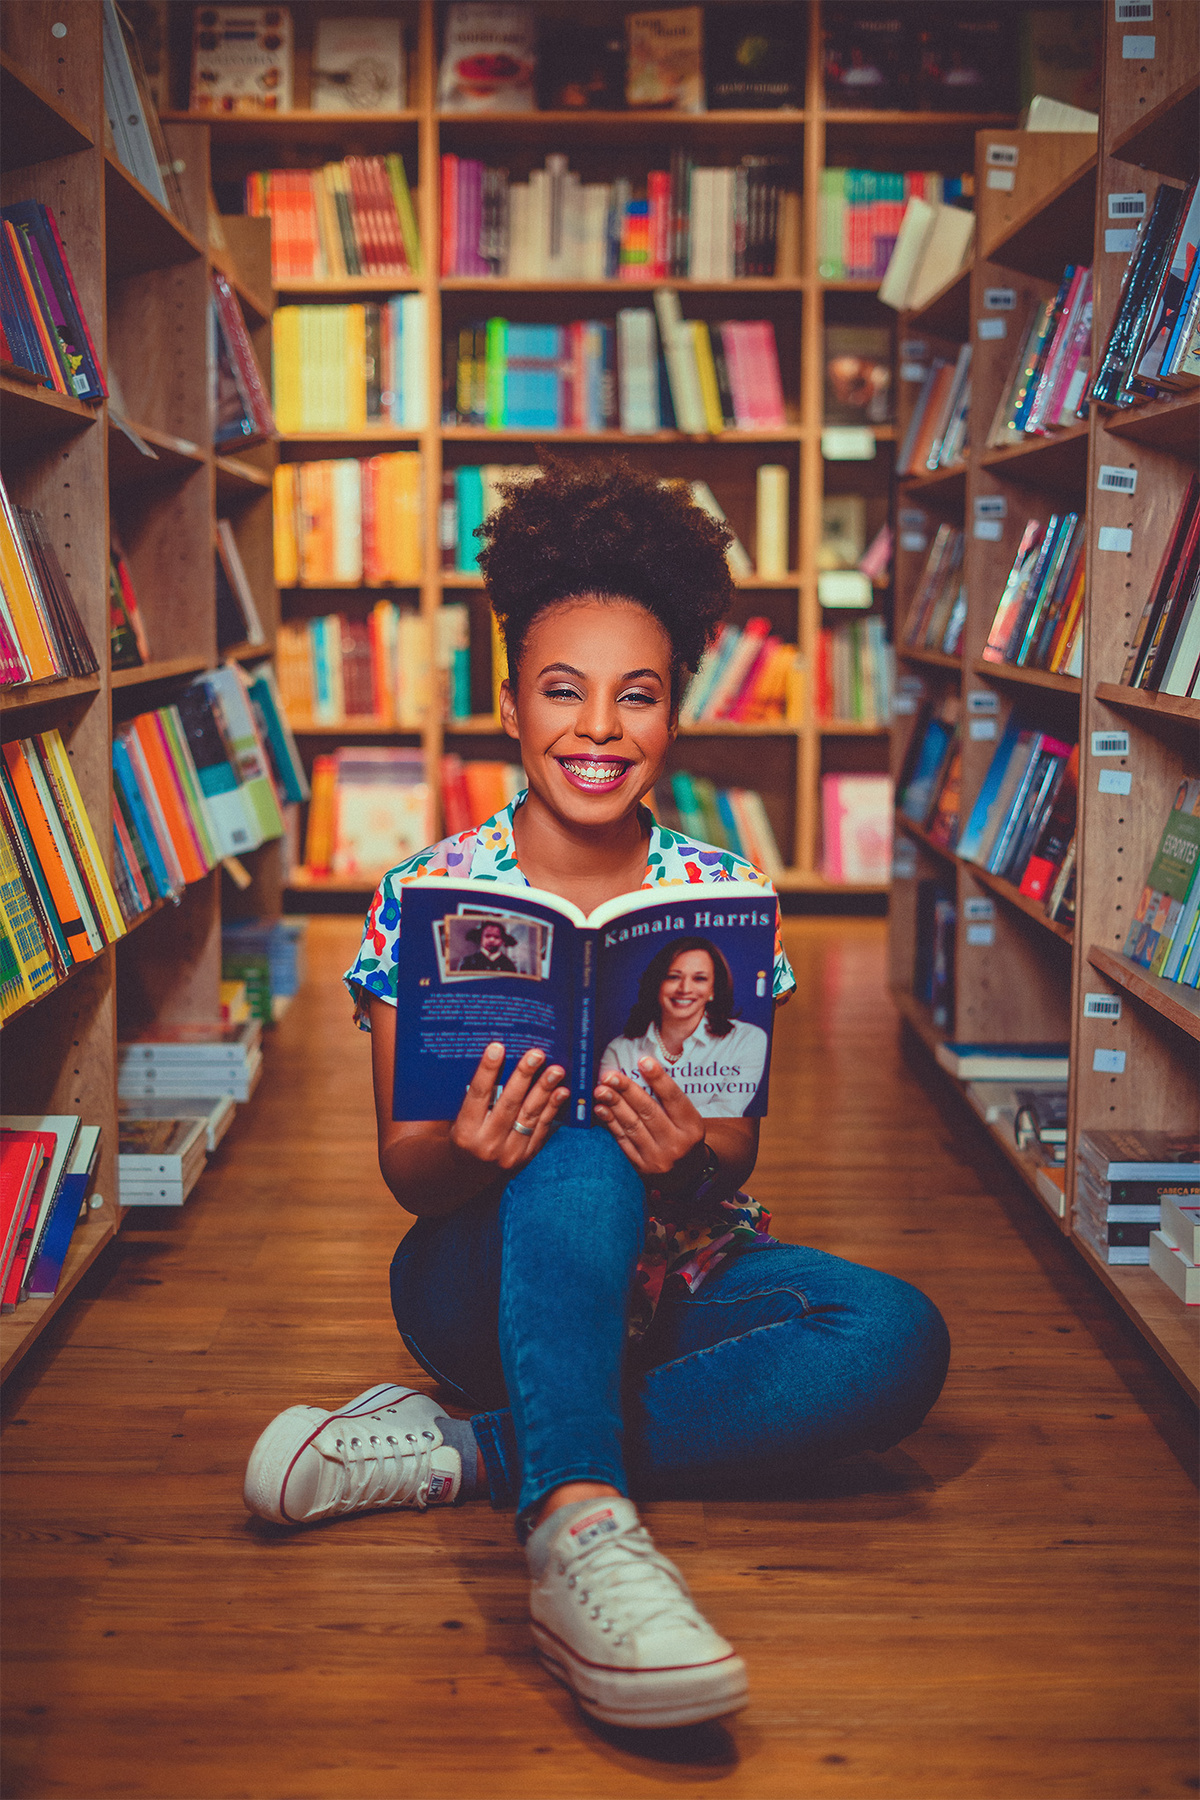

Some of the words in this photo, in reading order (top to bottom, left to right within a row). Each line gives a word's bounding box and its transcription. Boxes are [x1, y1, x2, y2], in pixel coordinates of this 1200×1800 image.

[14, 835, 31, 878] INFERNO
[1162, 834, 1198, 865] ESPORTES
[604, 914, 686, 948] Kamala
[694, 910, 770, 928] Harris
[664, 1061, 741, 1078] erdades
[684, 1082, 757, 1094] movem
[1157, 1187, 1190, 1196] CABEÇA
